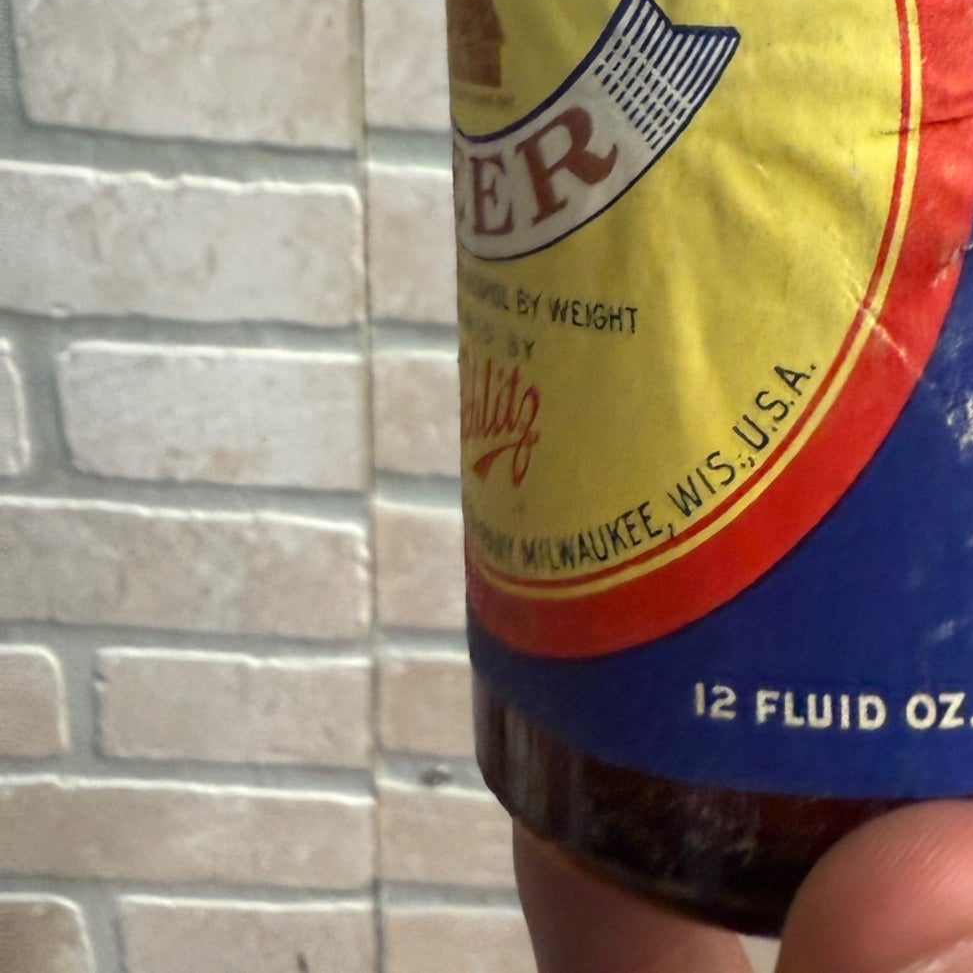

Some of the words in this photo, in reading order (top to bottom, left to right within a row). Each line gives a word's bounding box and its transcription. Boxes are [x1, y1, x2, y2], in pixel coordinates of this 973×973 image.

[454, 106, 618, 236] ER
[516, 288, 542, 316] BY
[549, 297, 637, 334] WEIGHT
[732, 363, 817, 451] U.S.A.
[694, 682, 737, 720] 12
[756, 690, 887, 730] FLUID
